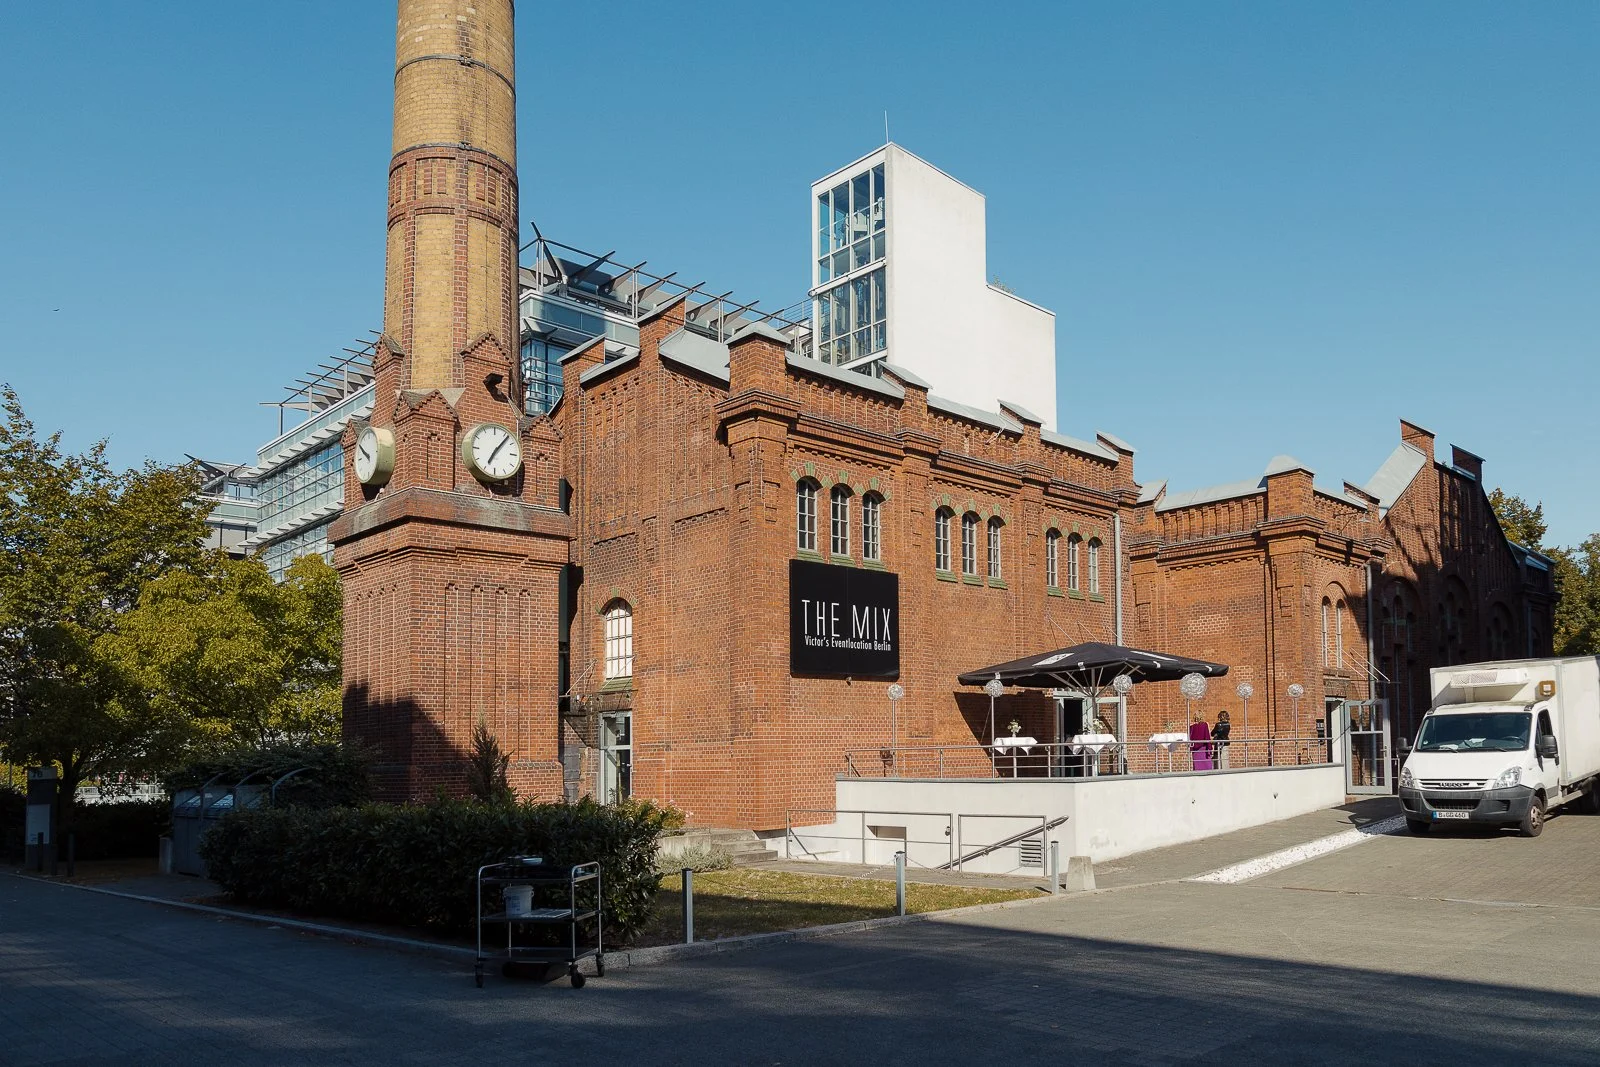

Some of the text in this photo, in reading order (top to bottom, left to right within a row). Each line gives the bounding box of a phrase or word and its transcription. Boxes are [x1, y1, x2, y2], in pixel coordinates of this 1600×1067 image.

[802, 599, 891, 641] THE MIX
[805, 635, 830, 647] Victor's
[873, 640, 892, 651] Berlin
